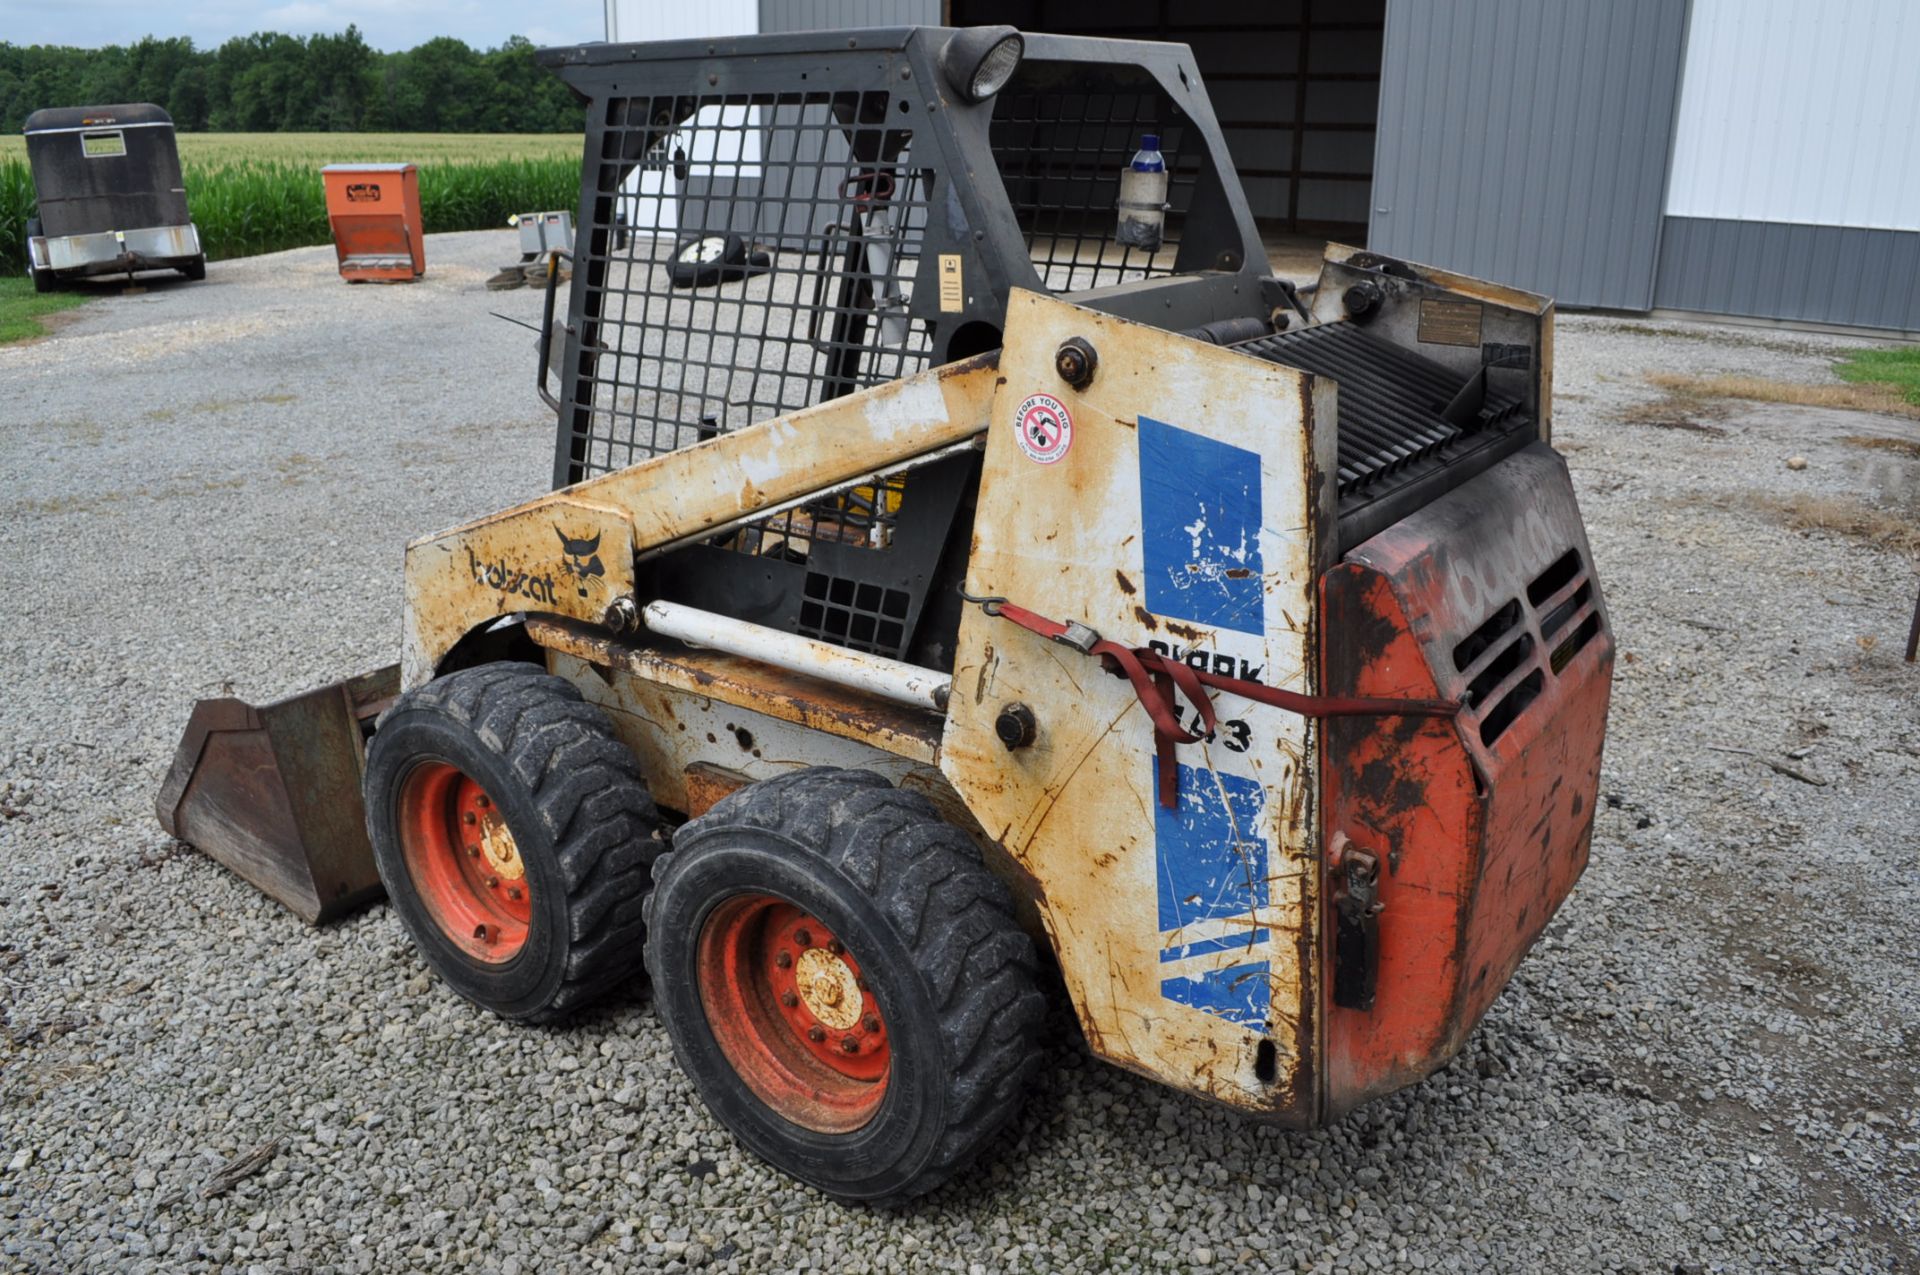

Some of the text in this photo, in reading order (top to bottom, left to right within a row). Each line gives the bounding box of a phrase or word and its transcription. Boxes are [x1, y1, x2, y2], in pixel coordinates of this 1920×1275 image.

[1016, 397, 1069, 429] BEFORE YOU DIG
[464, 544, 558, 606] bobcat
